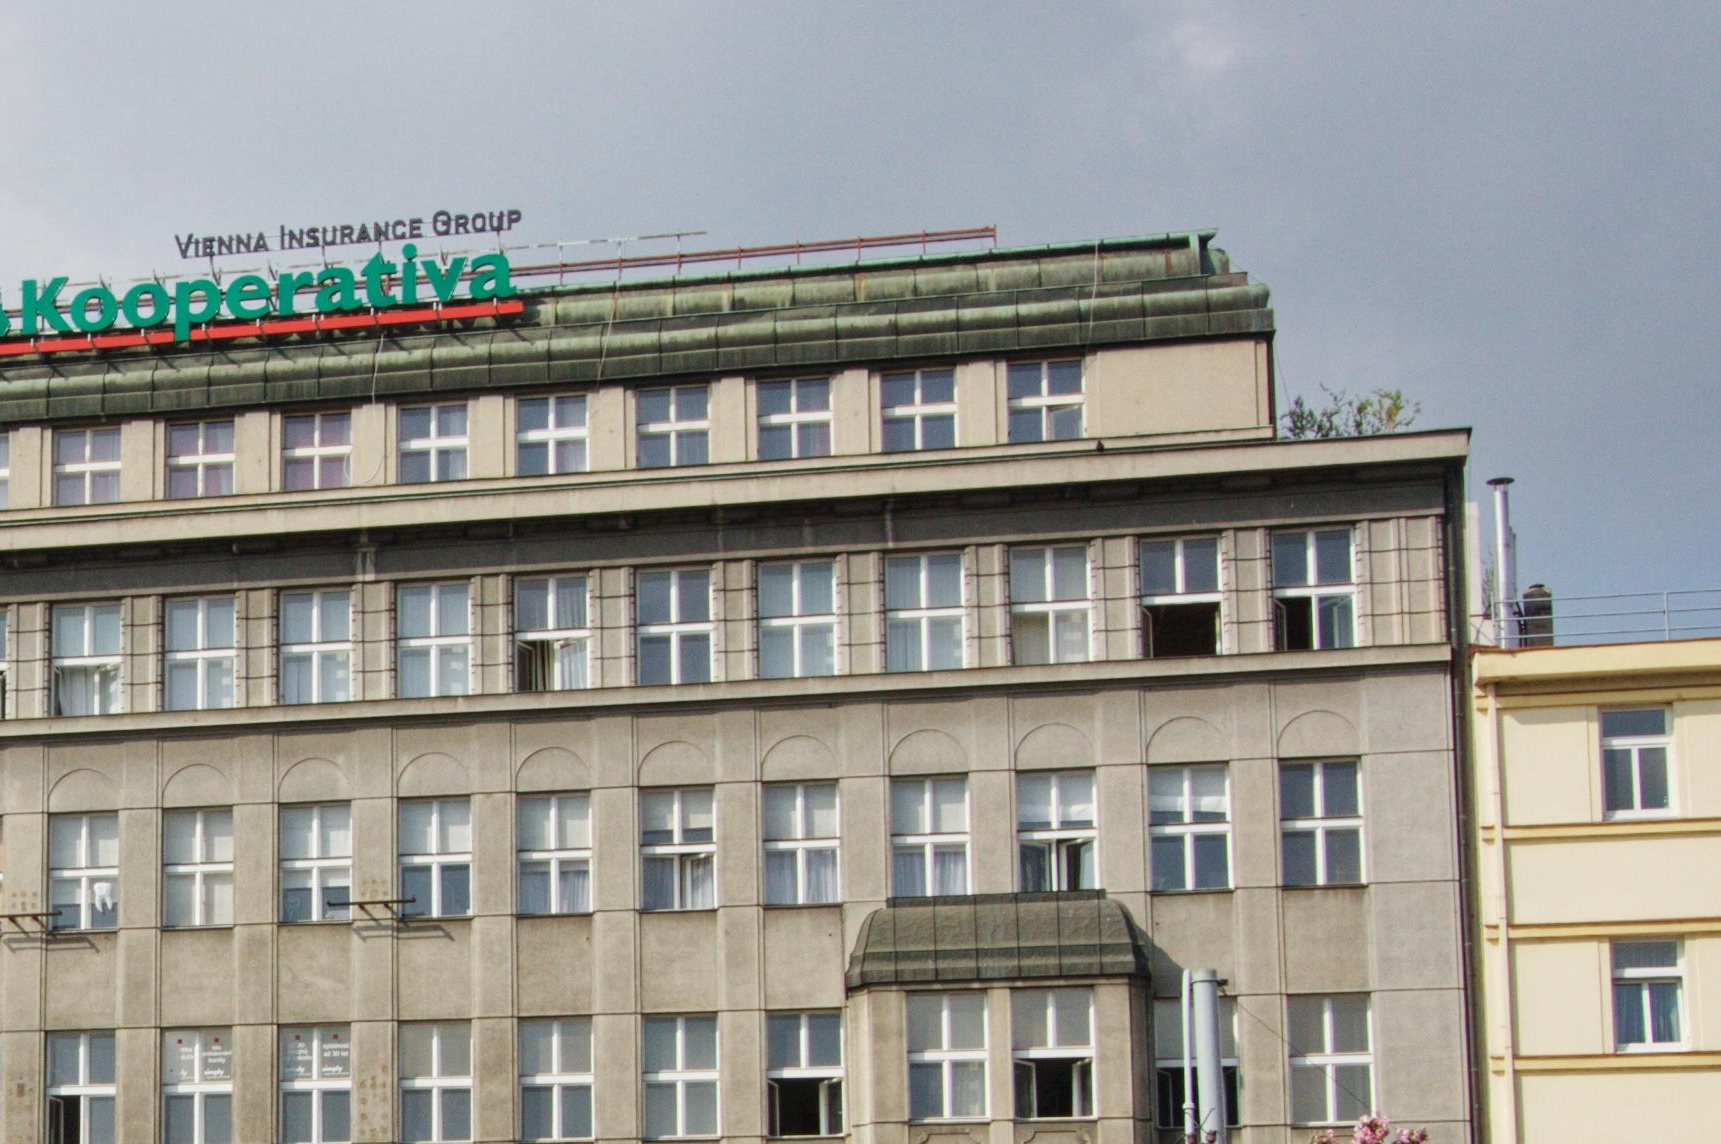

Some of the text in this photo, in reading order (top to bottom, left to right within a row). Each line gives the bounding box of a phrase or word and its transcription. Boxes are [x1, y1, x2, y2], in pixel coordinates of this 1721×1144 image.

[174, 209, 522, 259] VIENNA INSURANCE GROUP
[20, 242, 518, 341] Kooperativa
